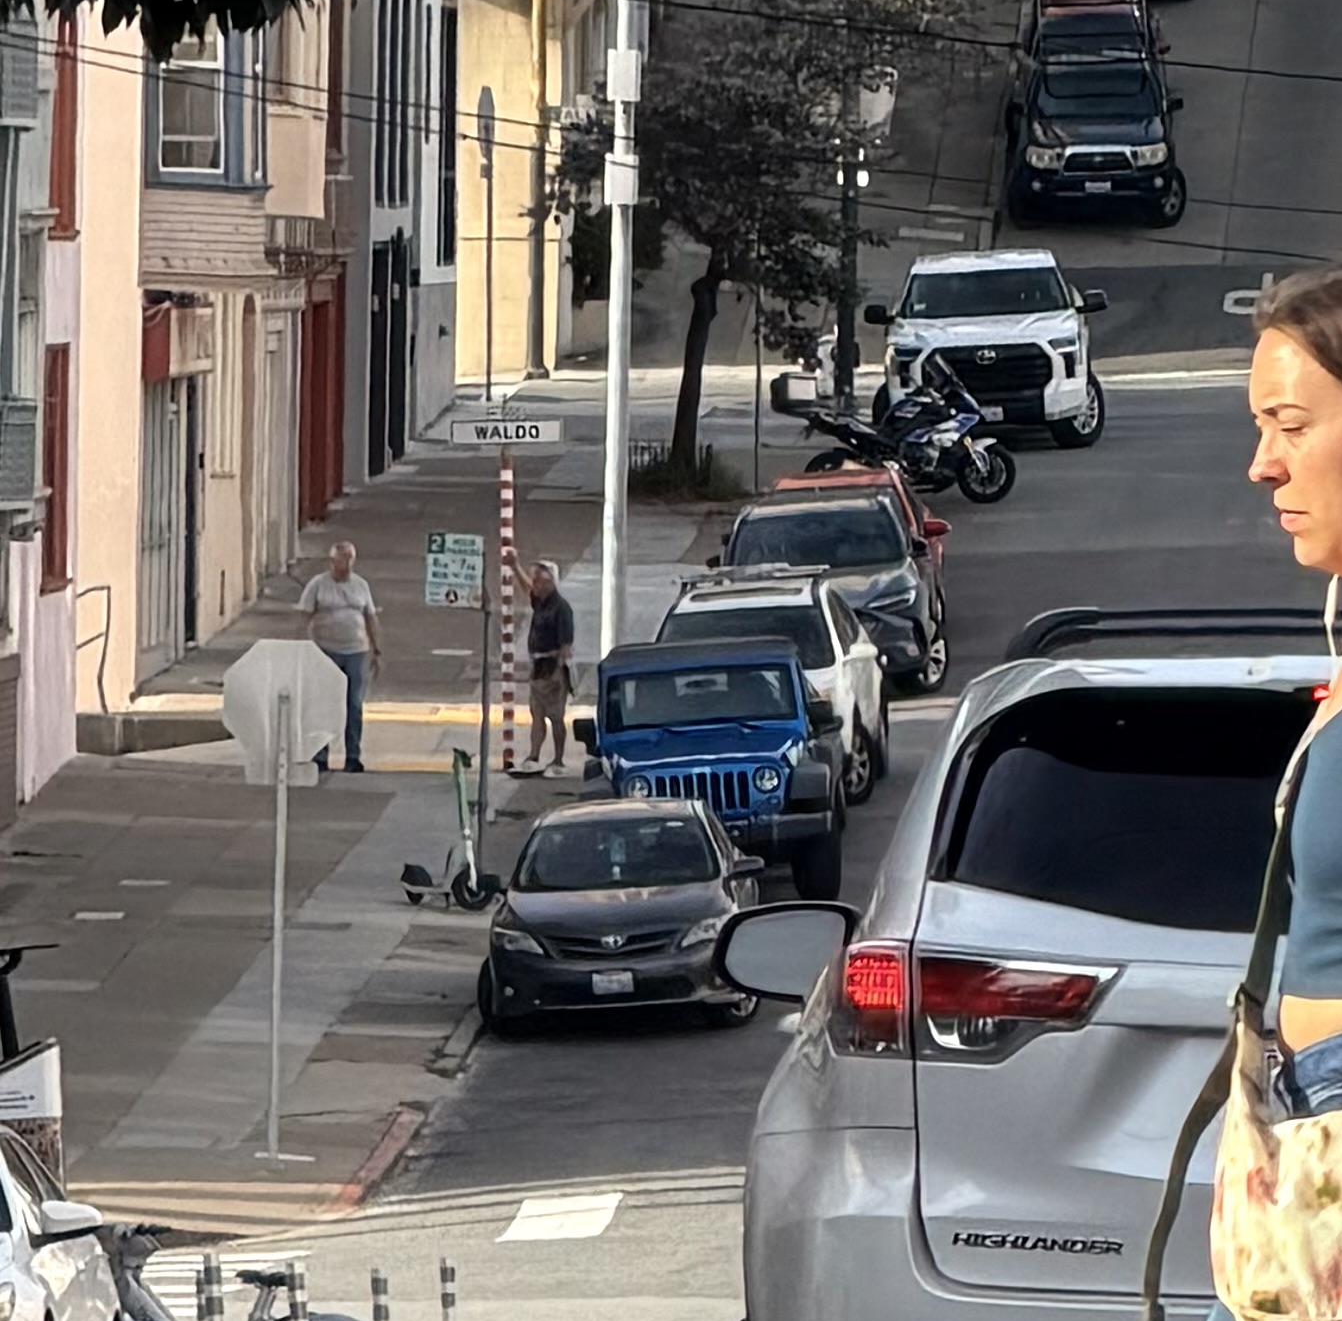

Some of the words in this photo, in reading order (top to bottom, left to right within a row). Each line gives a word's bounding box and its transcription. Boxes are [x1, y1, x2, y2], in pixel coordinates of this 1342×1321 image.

[475, 425, 540, 440] WALDO
[431, 535, 442, 551] 2
[952, 1232, 1124, 1255] HIGHLANDER
